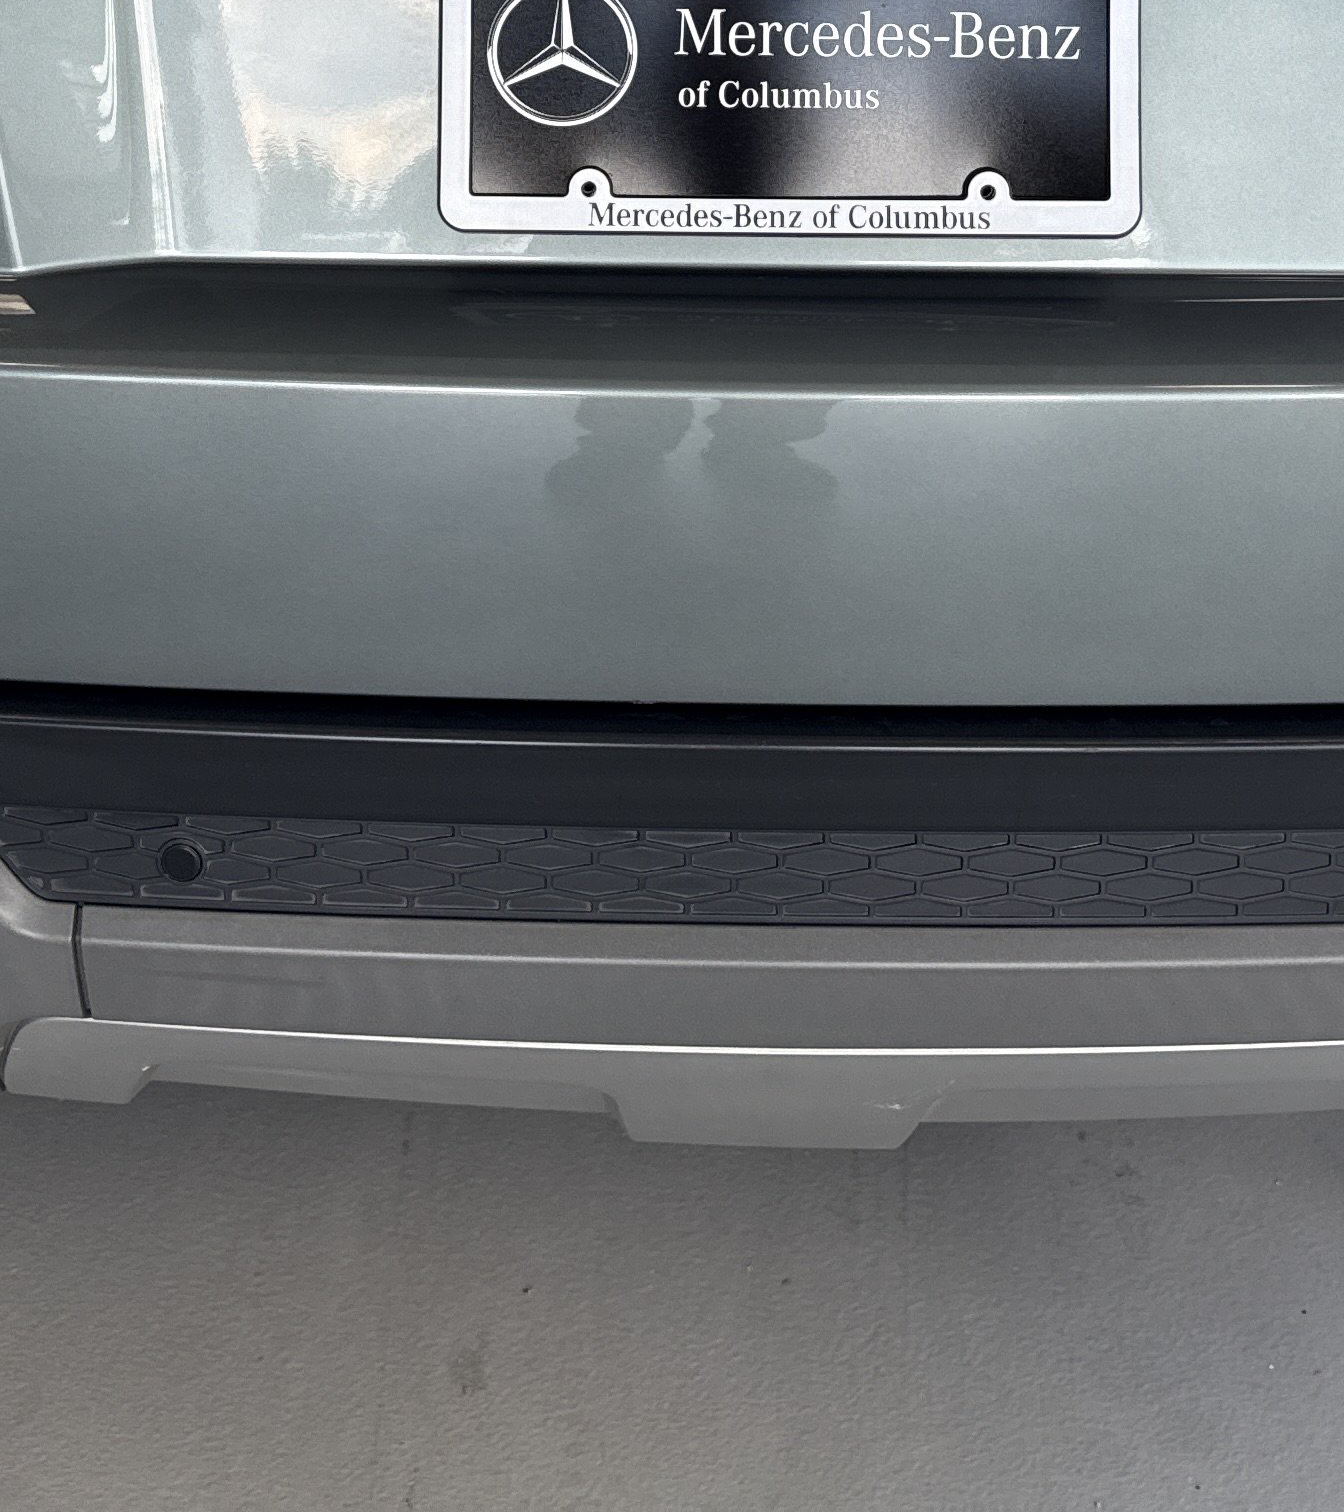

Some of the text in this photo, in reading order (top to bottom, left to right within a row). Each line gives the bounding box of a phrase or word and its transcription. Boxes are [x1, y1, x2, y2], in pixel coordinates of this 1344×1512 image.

[673, 7, 1082, 62] Mercedes-Benz
[677, 80, 882, 112] of Columbus
[587, 201, 992, 232] Mercedes-Benz of Columbus
